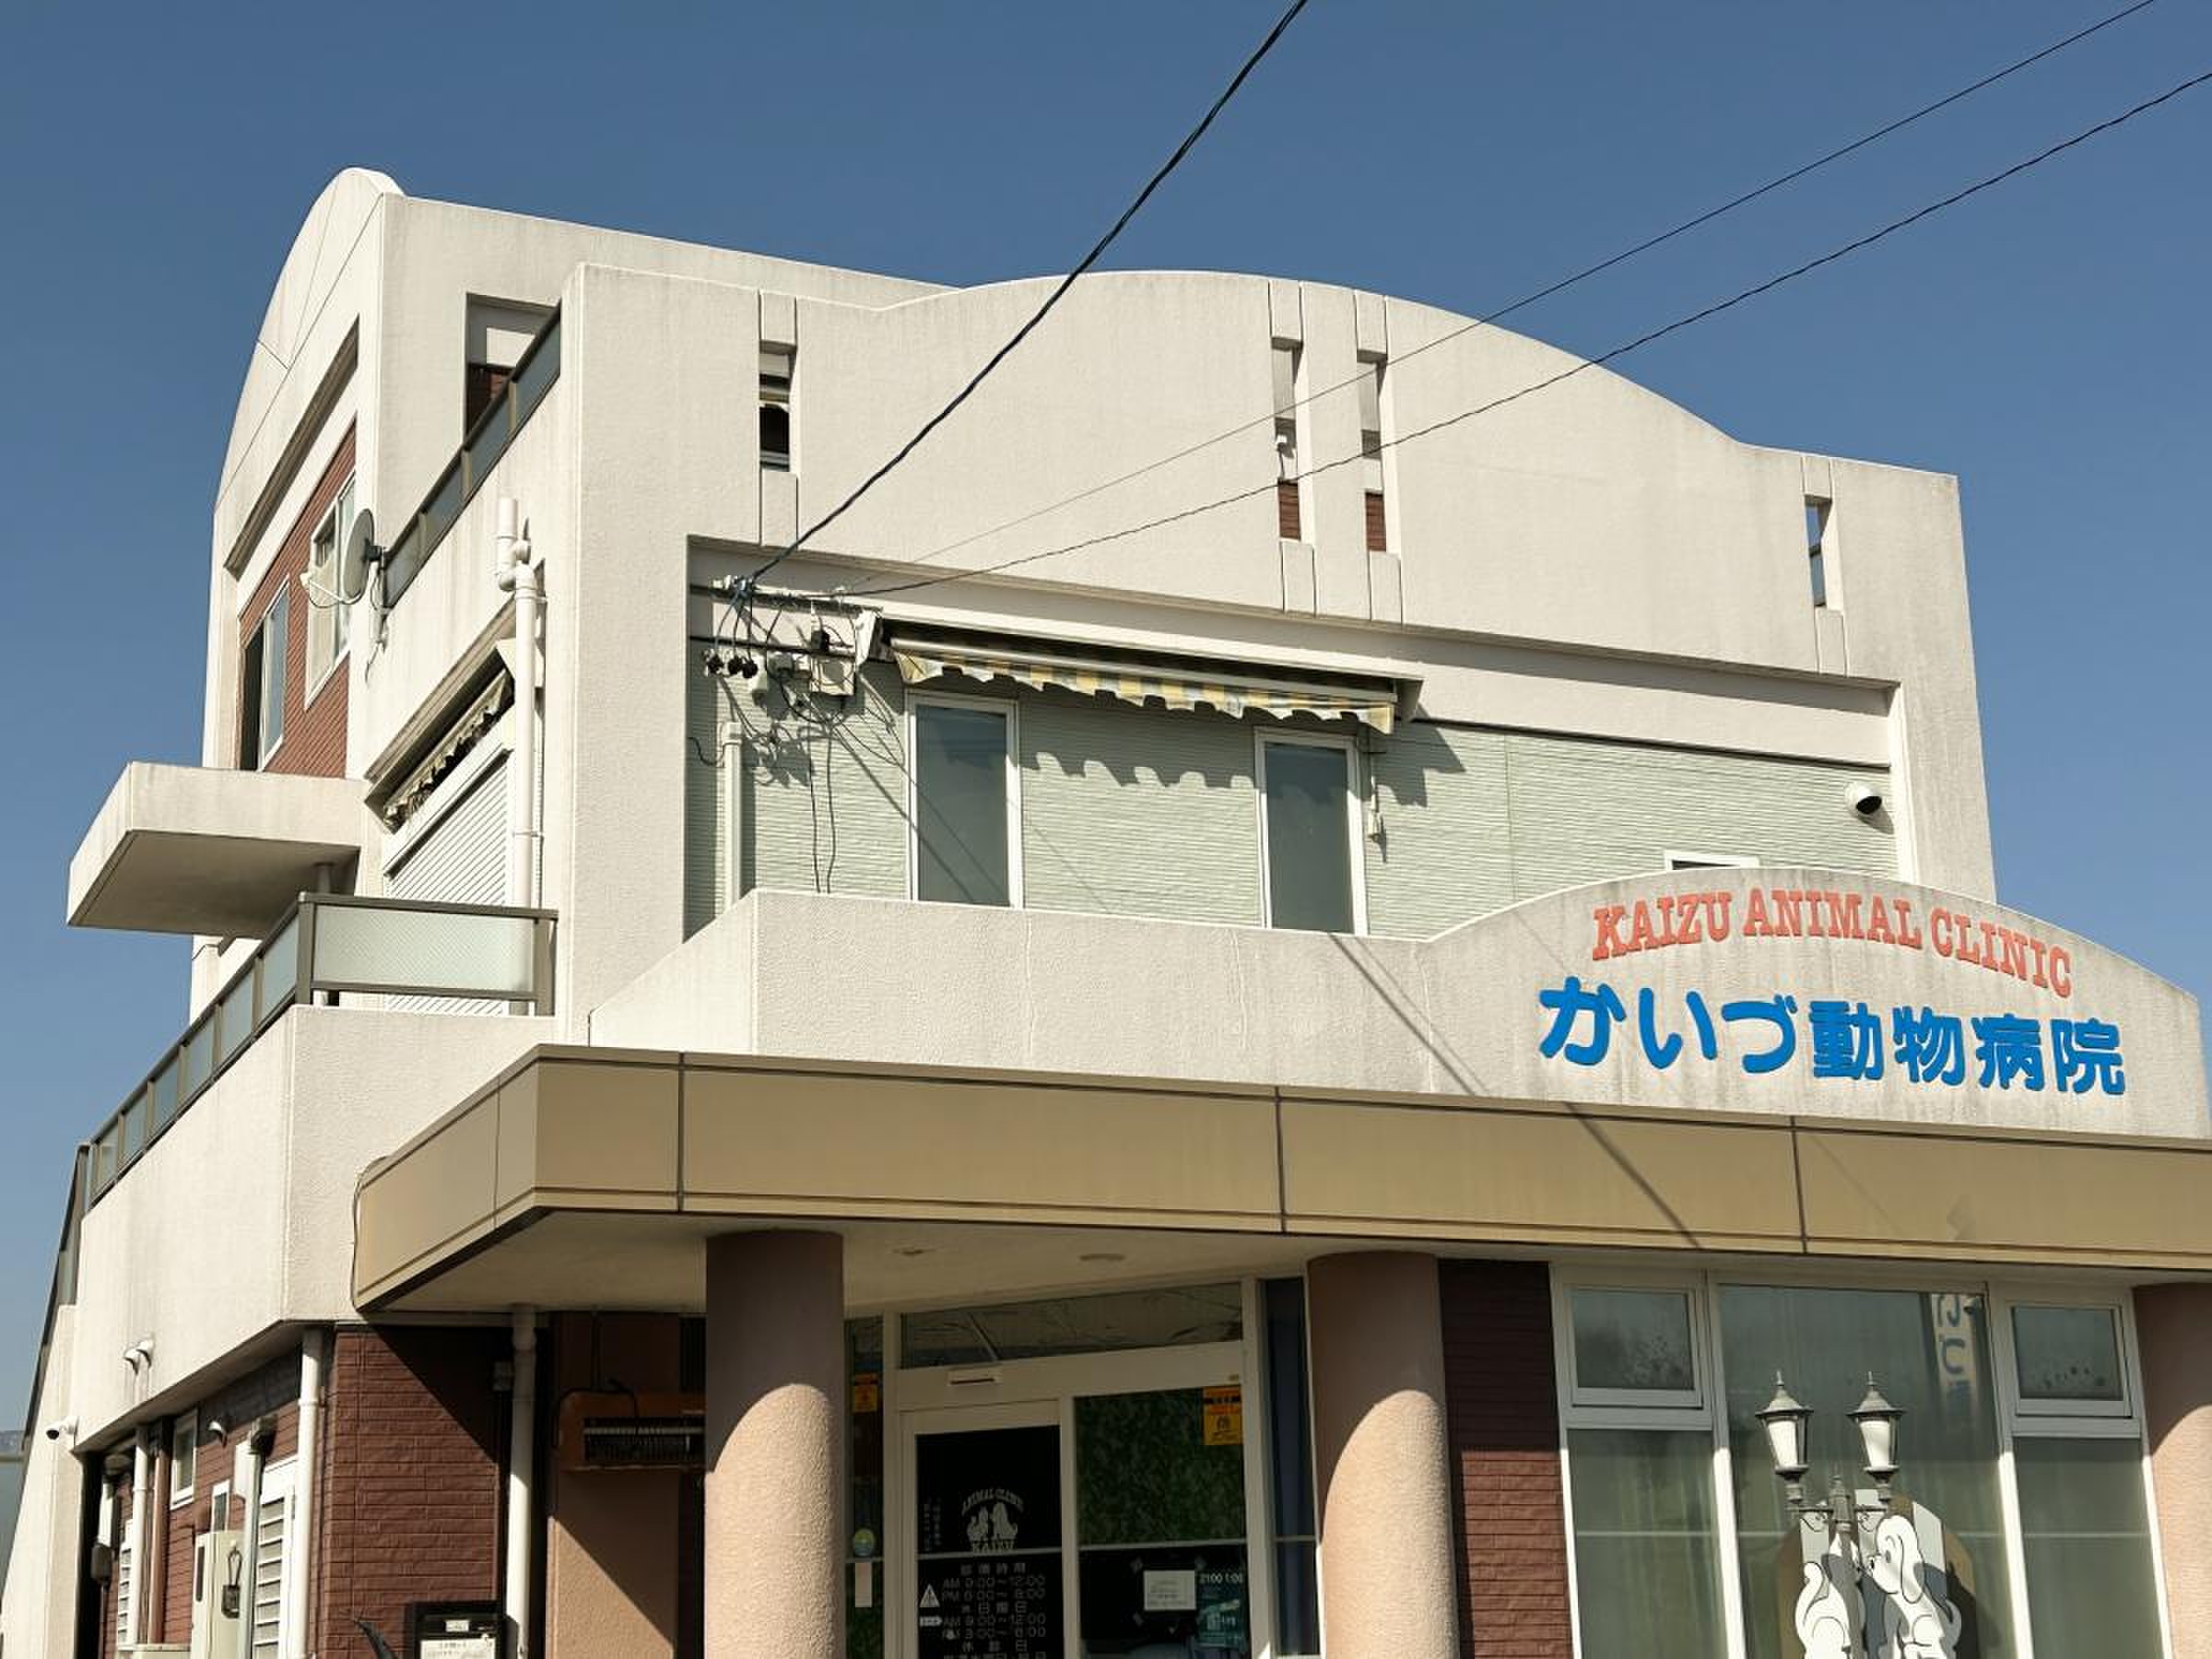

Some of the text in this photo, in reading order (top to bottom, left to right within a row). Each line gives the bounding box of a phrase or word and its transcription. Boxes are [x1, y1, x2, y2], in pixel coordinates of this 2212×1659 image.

[1592, 888, 2072, 998] KAIZU ANIMAL CLINIC
[1538, 976, 2125, 1095] かいづ動物病院
